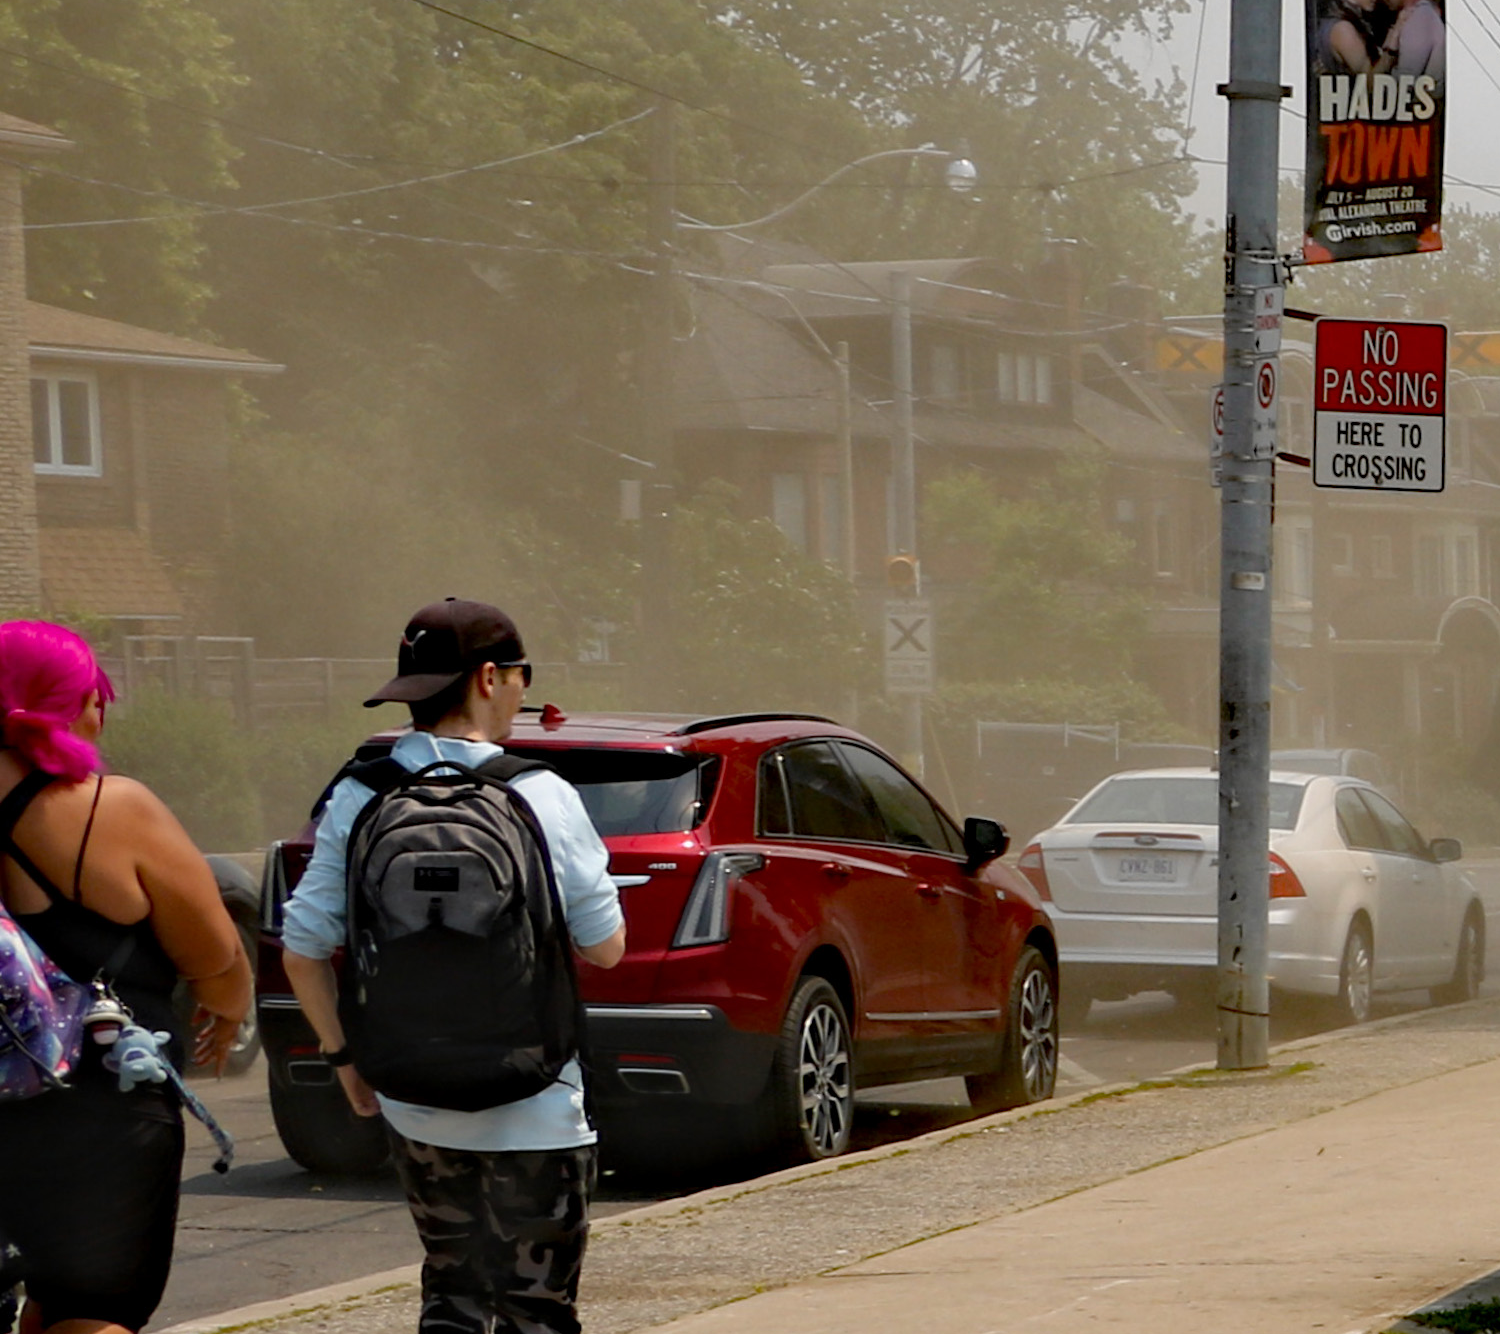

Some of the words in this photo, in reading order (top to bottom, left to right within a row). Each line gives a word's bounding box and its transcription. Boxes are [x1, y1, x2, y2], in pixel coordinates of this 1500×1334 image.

[1319, 73, 1436, 122] HADES
[1320, 122, 1430, 186] TOWN
[1364, 186, 1400, 201] AUGUST
[1400, 185, 1414, 199] 20
[1337, 201, 1389, 221] ALEXANDRA
[1389, 198, 1428, 215] THEATRE
[1325, 219, 1417, 243] mirvish.com
[1363, 328, 1399, 366] NO
[1323, 367, 1438, 409] PASSING
[1337, 421, 1385, 447] HERE
[1398, 423, 1422, 449] TO
[1332, 453, 1427, 482] CROSSING
[648, 862, 677, 871] 400
